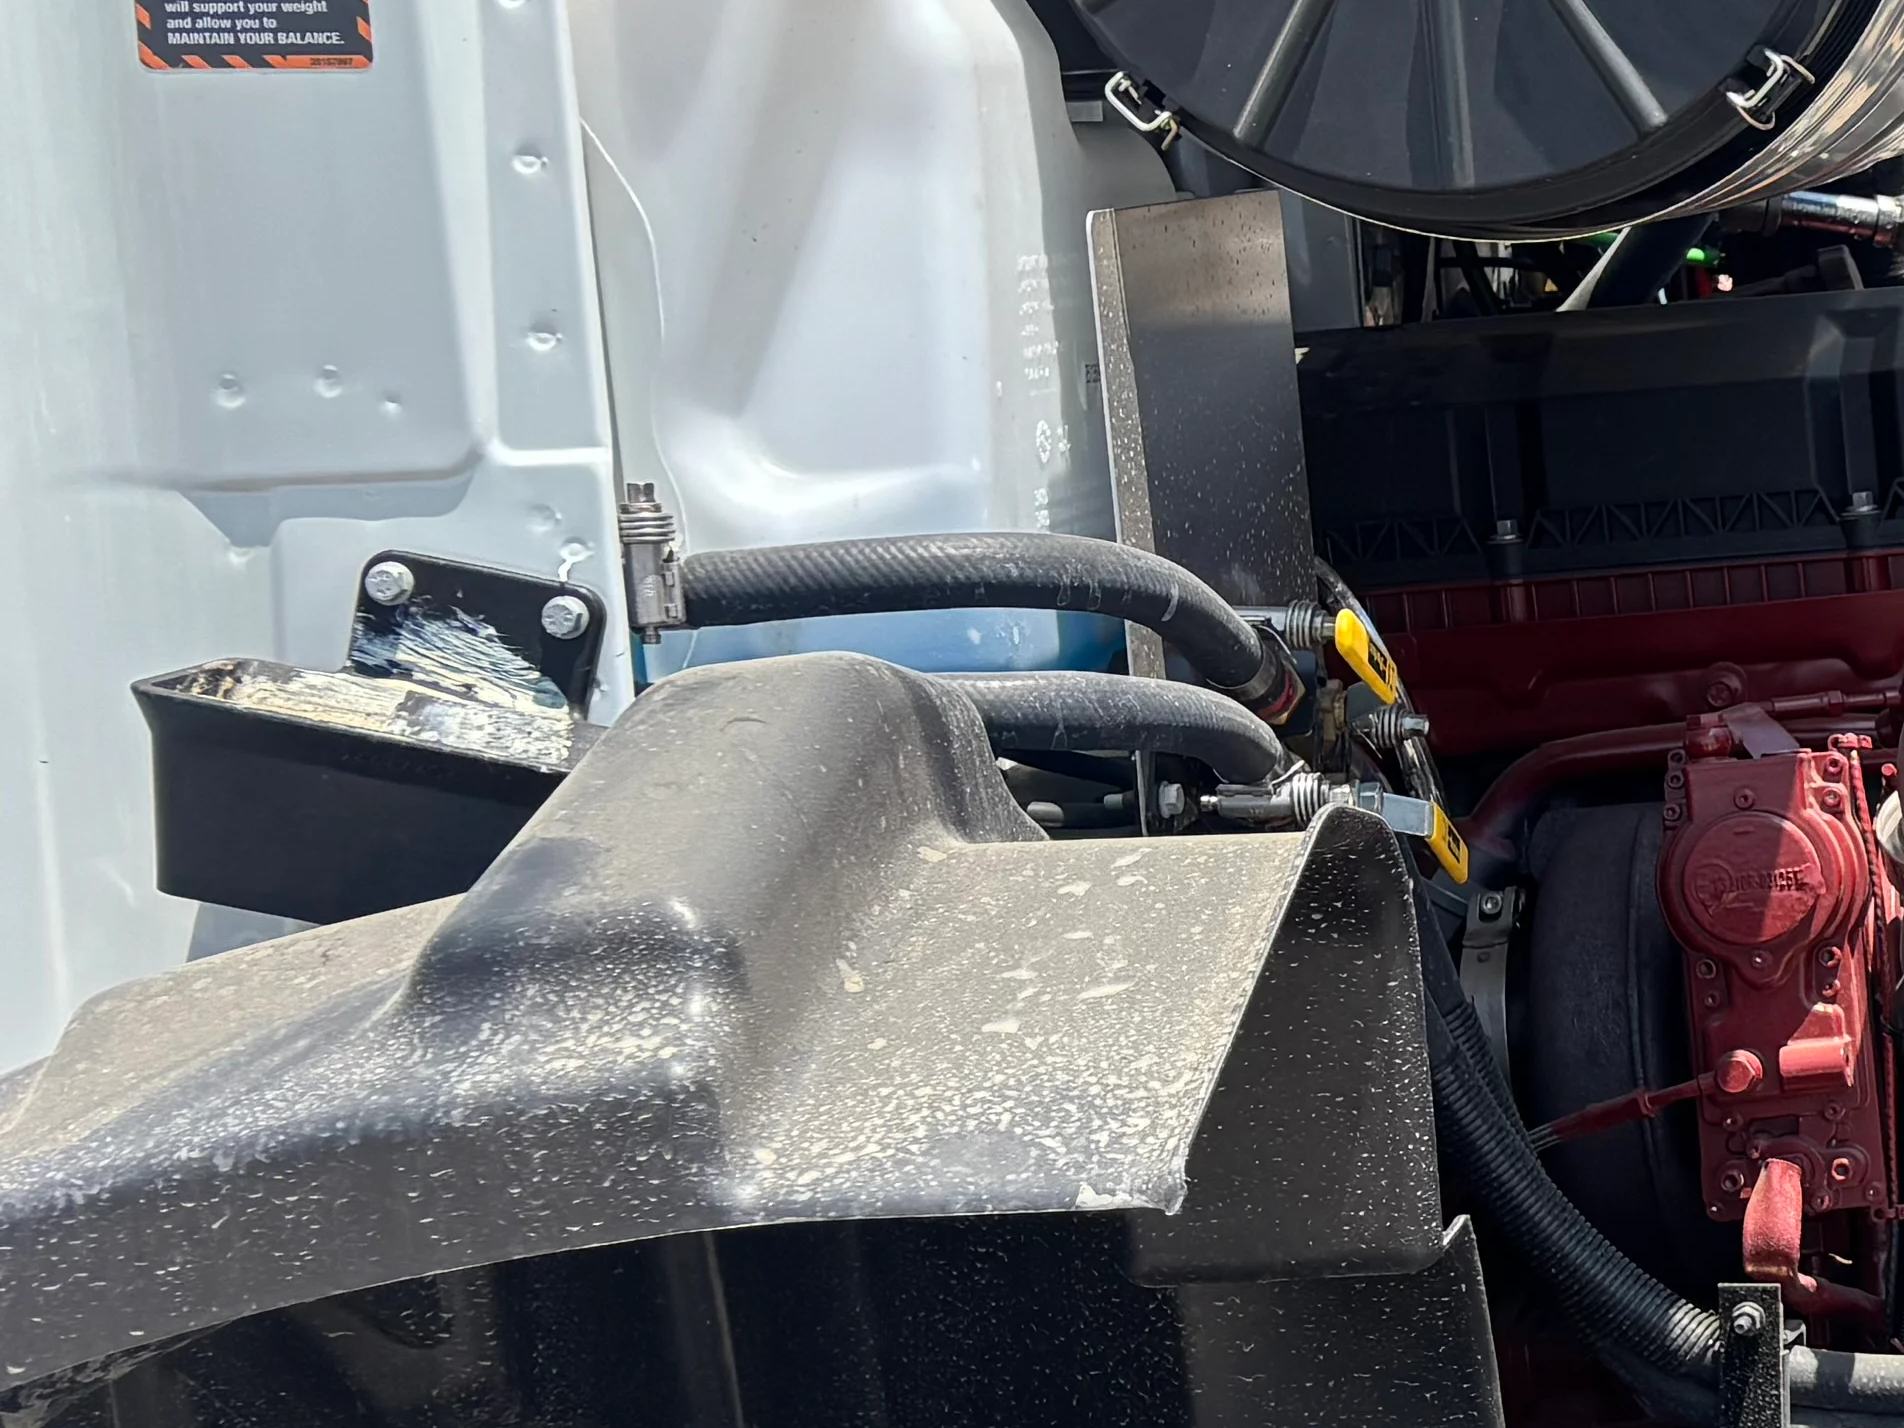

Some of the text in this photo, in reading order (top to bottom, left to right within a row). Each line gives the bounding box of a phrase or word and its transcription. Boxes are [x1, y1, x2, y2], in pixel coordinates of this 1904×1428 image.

[165, 1, 327, 15] will support your weight
[167, 17, 277, 31] and allow you to
[168, 32, 344, 44] MAINTAIN YOUR BALANCE.
